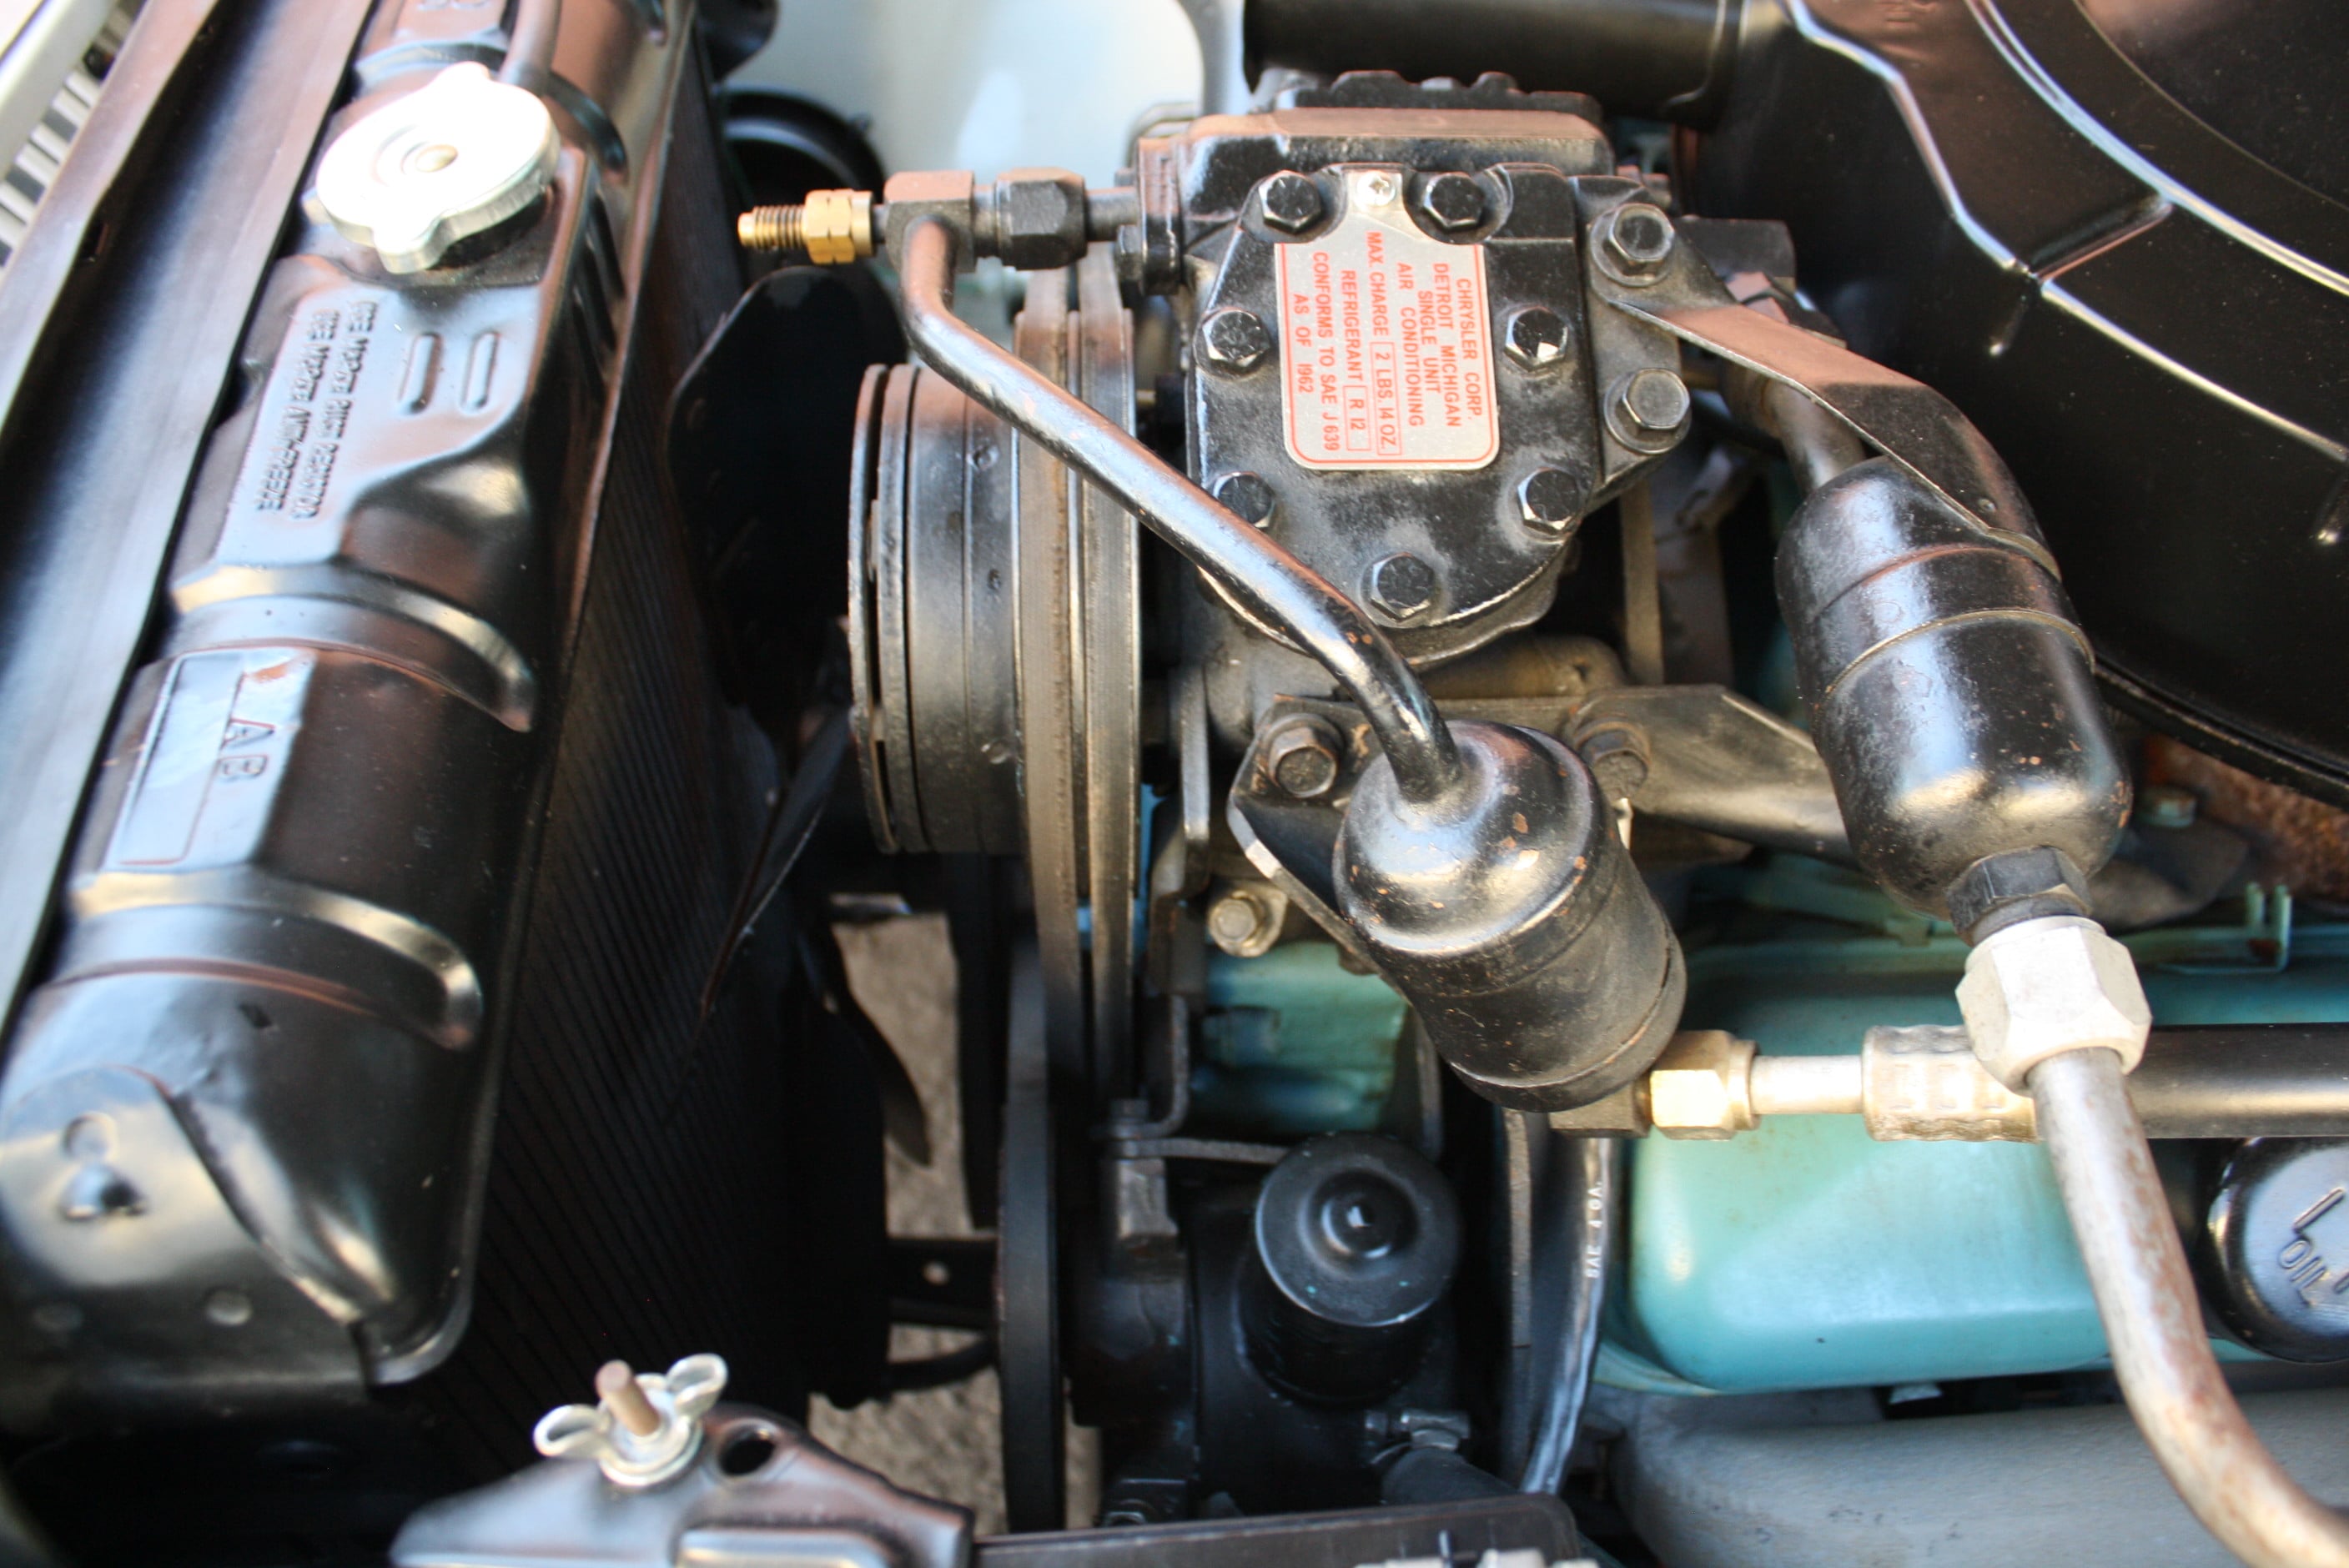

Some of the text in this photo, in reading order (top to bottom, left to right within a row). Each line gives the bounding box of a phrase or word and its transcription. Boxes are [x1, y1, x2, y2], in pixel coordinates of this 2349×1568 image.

[1294, 294, 1315, 393] AS OF 1962
[1312, 252, 1335, 339] CONFORMS
[1366, 231, 1396, 450] MAX. CHARGE 2 LBS. 14 OZ.
[1396, 262, 1426, 427] AIR CONDITIONING
[1417, 290, 1441, 394] SINGLE UNIT
[1432, 263, 1462, 428] DETROIT MICHIGAN
[1319, 347, 1335, 367] TO
[1320, 374, 1338, 405] SAE
[1340, 269, 1366, 430] REFRIGERANT R 12
[1456, 278, 1483, 420] CHRYSLER CORP.
[1322, 425, 1340, 451] 639
